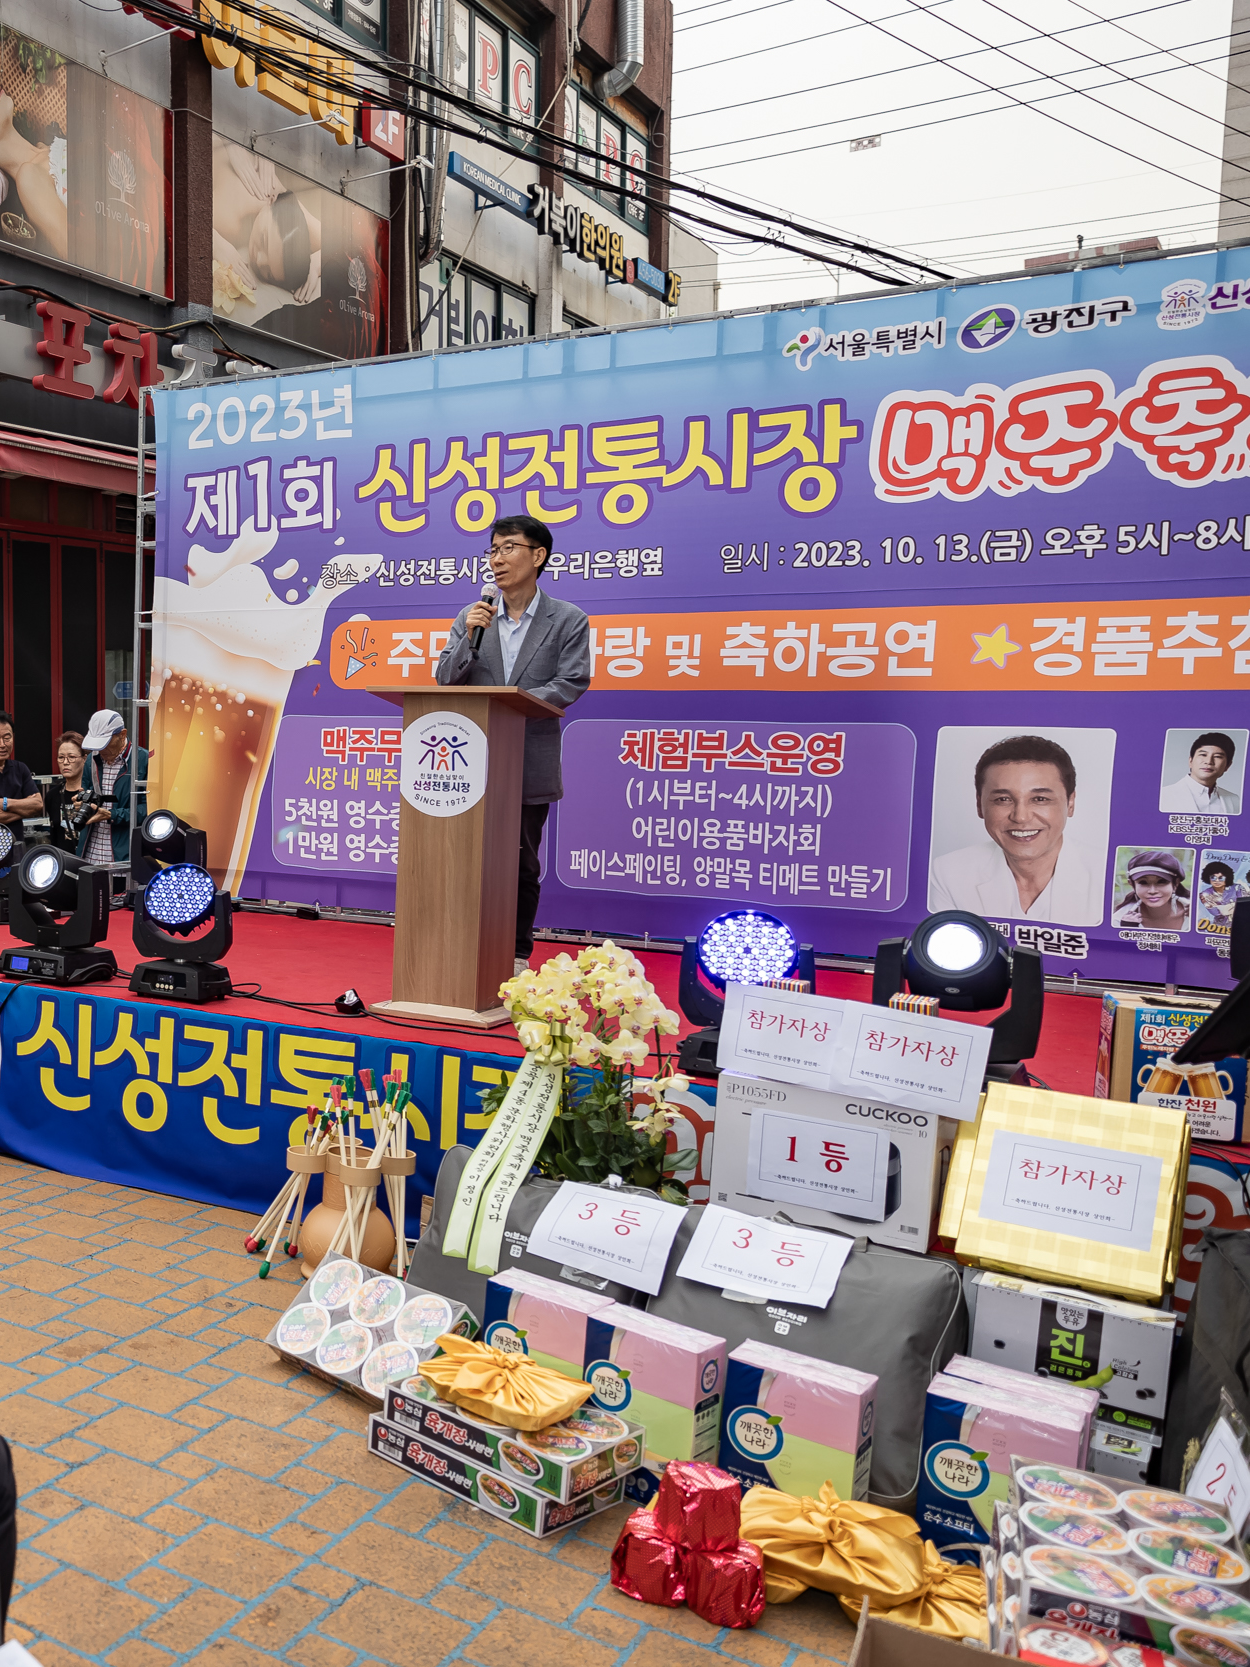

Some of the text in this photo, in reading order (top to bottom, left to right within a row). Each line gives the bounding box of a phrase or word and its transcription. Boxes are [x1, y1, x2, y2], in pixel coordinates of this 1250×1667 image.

[463, 160, 523, 207] KOREAN MEDICAL CLINIC
[95, 200, 150, 234] Olive Aroma
[638, 261, 664, 294] 456-5030
[667, 270, 682, 305] 2F
[339, 299, 375, 322] Olive Aroma
[1024, 301, 1134, 333] 광진구
[1161, 311, 1201, 321] 신성전통시장
[823, 319, 944, 359] 서울특별시
[32, 301, 164, 414] 포차
[186, 383, 353, 452] 2023년
[355, 401, 860, 535] 신성전통시장
[185, 454, 338, 538] 제1회
[719, 539, 769, 573] 일시
[792, 538, 870, 569] 2023.
[880, 535, 924, 565] 10.
[1039, 524, 1106, 558] 오후
[319, 563, 361, 590] 장소
[544, 546, 664, 580] 우리은행옆
[664, 618, 937, 679] 및 축하공연
[619, 728, 846, 777] 체험부스운영
[305, 766, 338, 791] 시장
[343, 766, 359, 791] 내
[413, 780, 471, 794] 신성전통시장
[284, 797, 339, 828] 5천원
[414, 793, 467, 807] SINCE 1972
[630, 815, 823, 857] 어린이용품바자회
[1170, 815, 1228, 826] 광진구홍보대사
[285, 831, 339, 861] 1만원
[569, 847, 892, 902] 페이스페인팅, 양말목 티메트 만들기
[1017, 928, 1088, 958] 박일준
[747, 1009, 832, 1043] 참가자상
[1140, 1012, 1166, 1024] 제1회
[864, 1029, 960, 1068] 참가자상
[525, 1072, 556, 1134] 신성전통시장
[845, 1103, 929, 1128] CUCKOO
[1157, 1097, 1217, 1114] 한잔 천원
[917, 1129, 928, 1139] 10
[507, 1133, 533, 1172] 맥주축제
[785, 1135, 850, 1173] 1 등
[1018, 1157, 1128, 1197] 참가자상
[488, 1172, 518, 1223] 축하드립니다
[577, 1202, 642, 1237] 3 등
[731, 1227, 806, 1268] 3 등
[766, 1306, 808, 1324] 이브자리
[1060, 1306, 1085, 1320] 맛있는
[1061, 1316, 1081, 1327] 두유
[494, 1334, 521, 1350] 깨끗한
[1050, 1328, 1086, 1367] 진
[1112, 1357, 1128, 1366] High
[595, 1373, 624, 1392] 깨끗한
[599, 1386, 618, 1402] 나라
[404, 1403, 423, 1418] 농심
[387, 1433, 405, 1448] 농심
[424, 1411, 495, 1458] 육개장 사발면
[739, 1420, 774, 1440] 깨끗한
[744, 1434, 767, 1450] 나라
[406, 1441, 473, 1489] 육개장 사발면
[573, 1468, 599, 1494] 육개장
[939, 1456, 979, 1477] 깨끗한
[944, 1470, 971, 1487] 나라
